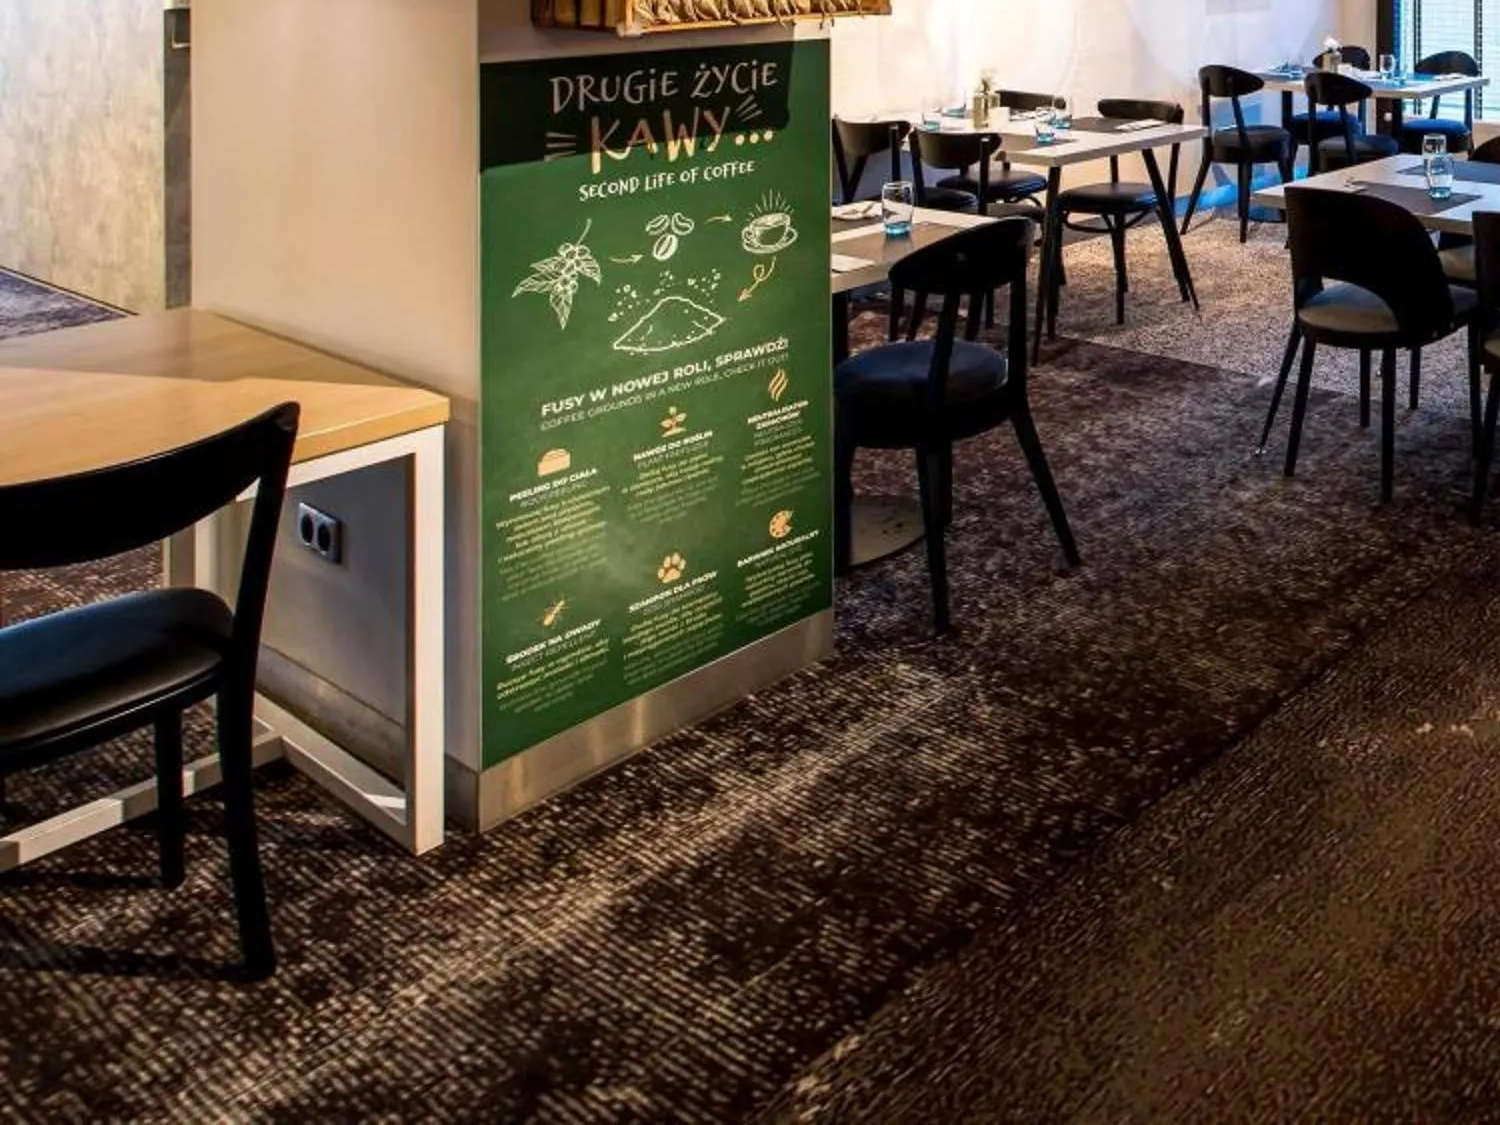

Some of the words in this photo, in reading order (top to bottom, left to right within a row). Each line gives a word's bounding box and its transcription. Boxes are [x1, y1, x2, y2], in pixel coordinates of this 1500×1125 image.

[578, 176, 641, 202] SECOND
[679, 167, 698, 184] OF
[703, 160, 756, 181] COFFEE
[541, 394, 585, 417] FUSY
[589, 387, 607, 403] W
[611, 371, 669, 396] NOWEJ
